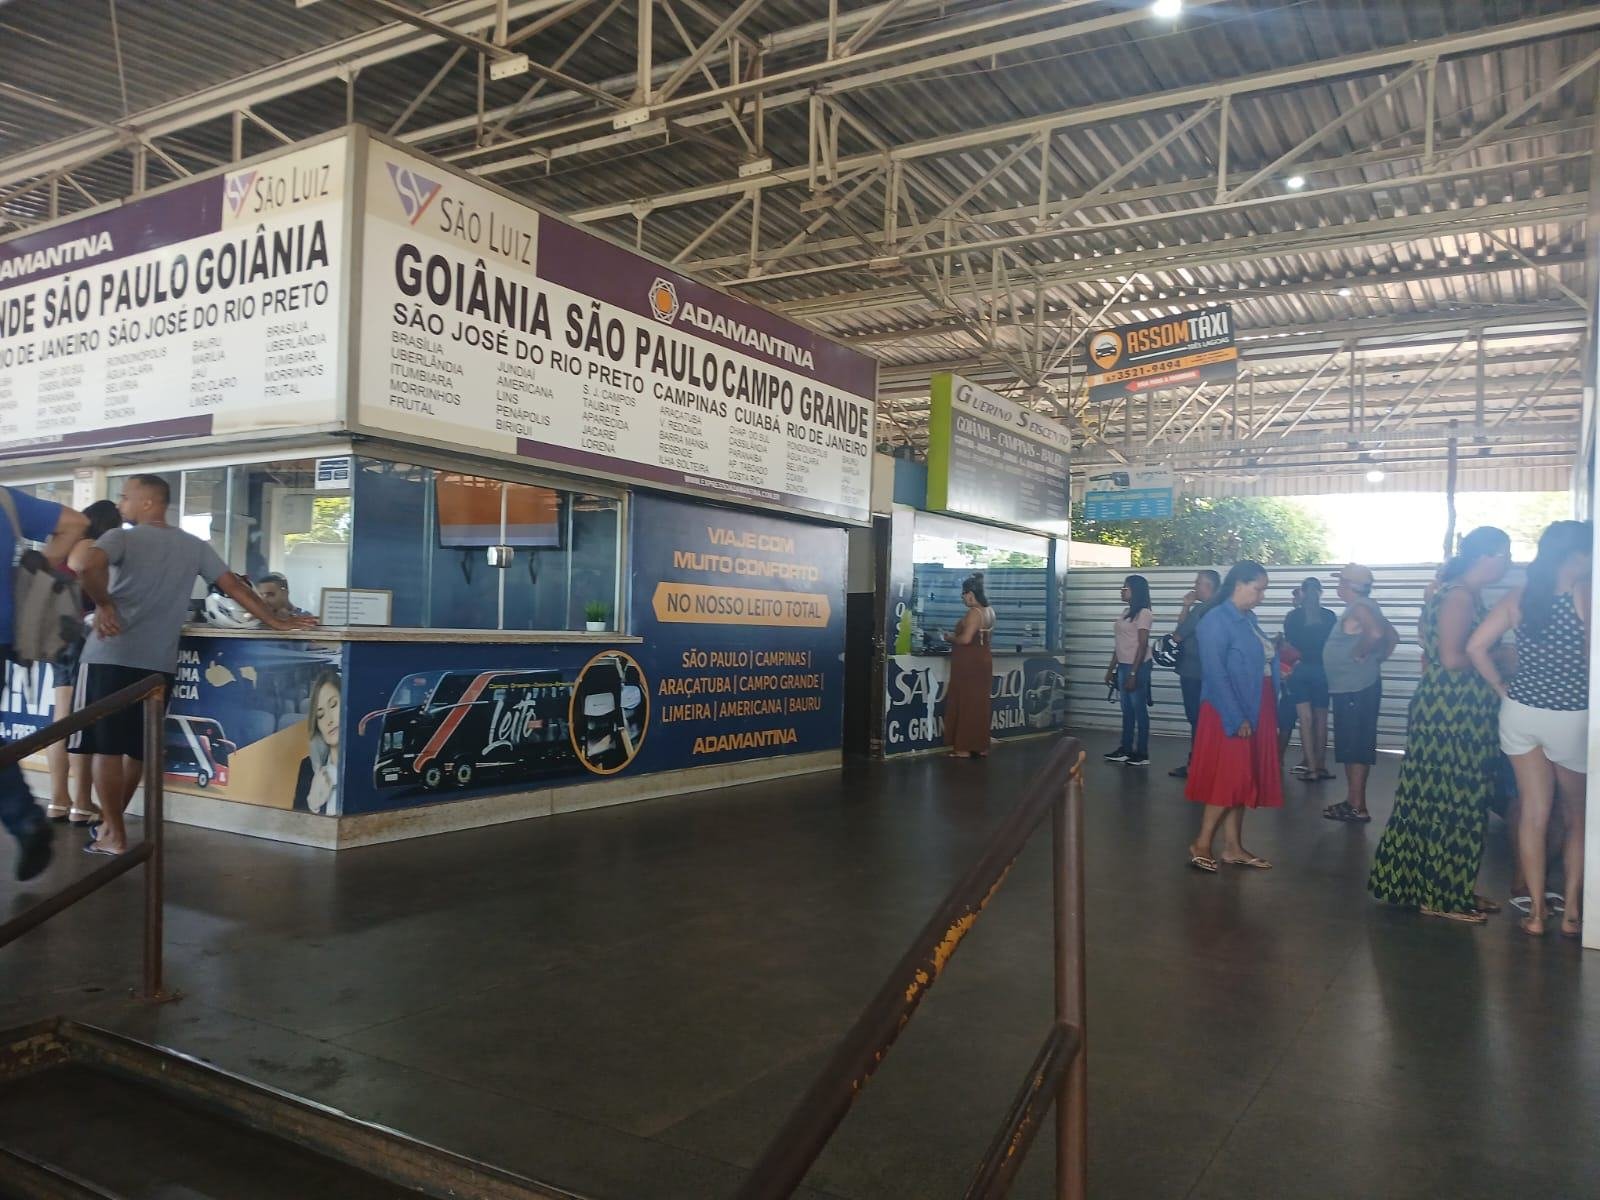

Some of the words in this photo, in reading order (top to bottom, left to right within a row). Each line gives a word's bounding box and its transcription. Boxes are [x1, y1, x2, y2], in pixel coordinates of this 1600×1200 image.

[255, 176, 285, 212] SÃO
[292, 165, 329, 203] LUIZ
[440, 197, 481, 244] SÃO
[489, 212, 531, 265] LUIZ
[196, 220, 329, 294] GOIÂNIA
[44, 274, 90, 328] SÃO
[100, 254, 188, 316] PAULO
[395, 243, 552, 340] GOIÂNIA
[109, 319, 140, 346] SÃO
[145, 304, 187, 339] JOSÉ
[194, 303, 218, 329] DO
[224, 300, 255, 324] RIO
[262, 280, 328, 316] PRETO
[18, 343, 34, 365] DE
[39, 330, 99, 361] JANEIRO
[392, 331, 444, 354] BRASÍLIA
[393, 302, 444, 336] SÃO
[452, 322, 509, 354] JOSÉ
[516, 339, 544, 365] DO
[551, 351, 582, 375] RIO
[588, 361, 645, 394] PRETO
[565, 300, 624, 361] SÃO
[635, 327, 718, 391] PAULO
[680, 302, 815, 370] ADAMANTINA
[391, 347, 464, 376] UBERLÂNDIA
[1118, 360, 1181, 380] 3521-9494
[390, 363, 453, 388] ITUMBIARA
[497, 376, 553, 399] AMERICANA
[390, 379, 461, 405] MORRINHOS
[390, 395, 435, 415] FRUTAL
[497, 390, 518, 404] LINS
[601, 390, 636, 407] CAMPOS
[653, 382, 728, 418] CAMPINAS
[722, 360, 794, 416] CAMPO
[800, 386, 869, 439] GRANDE
[583, 412, 629, 430] APARECIDA
[734, 407, 781, 434] CUIABÁ
[582, 439, 616, 452] LORENA
[787, 422, 806, 440] RIO
[809, 428, 822, 445] DE
[825, 434, 867, 457] JANEIRO
[707, 527, 756, 549] VIAJE
[758, 535, 795, 555] COM
[673, 551, 733, 573] MUITO
[735, 558, 820, 582] CONFORTO
[667, 592, 691, 613] NO
[696, 594, 744, 616] NOSSO
[748, 599, 782, 617] LEITO
[786, 601, 821, 618] TOTAL
[682, 648, 707, 668] SÃO
[710, 651, 747, 668] PAULO
[755, 651, 806, 667] CAMPINAS
[658, 677, 731, 698] ARAÇATUBA
[739, 676, 778, 691] CAMPO
[780, 674, 820, 690] GRANDE
[662, 704, 710, 723] LIMEIRA
[720, 700, 782, 719] AMERICANA
[790, 696, 821, 713] BAURU
[482, 692, 537, 756] Leito
[889, 720, 904, 743] C.
[692, 728, 798, 755] ADAMANTINA
